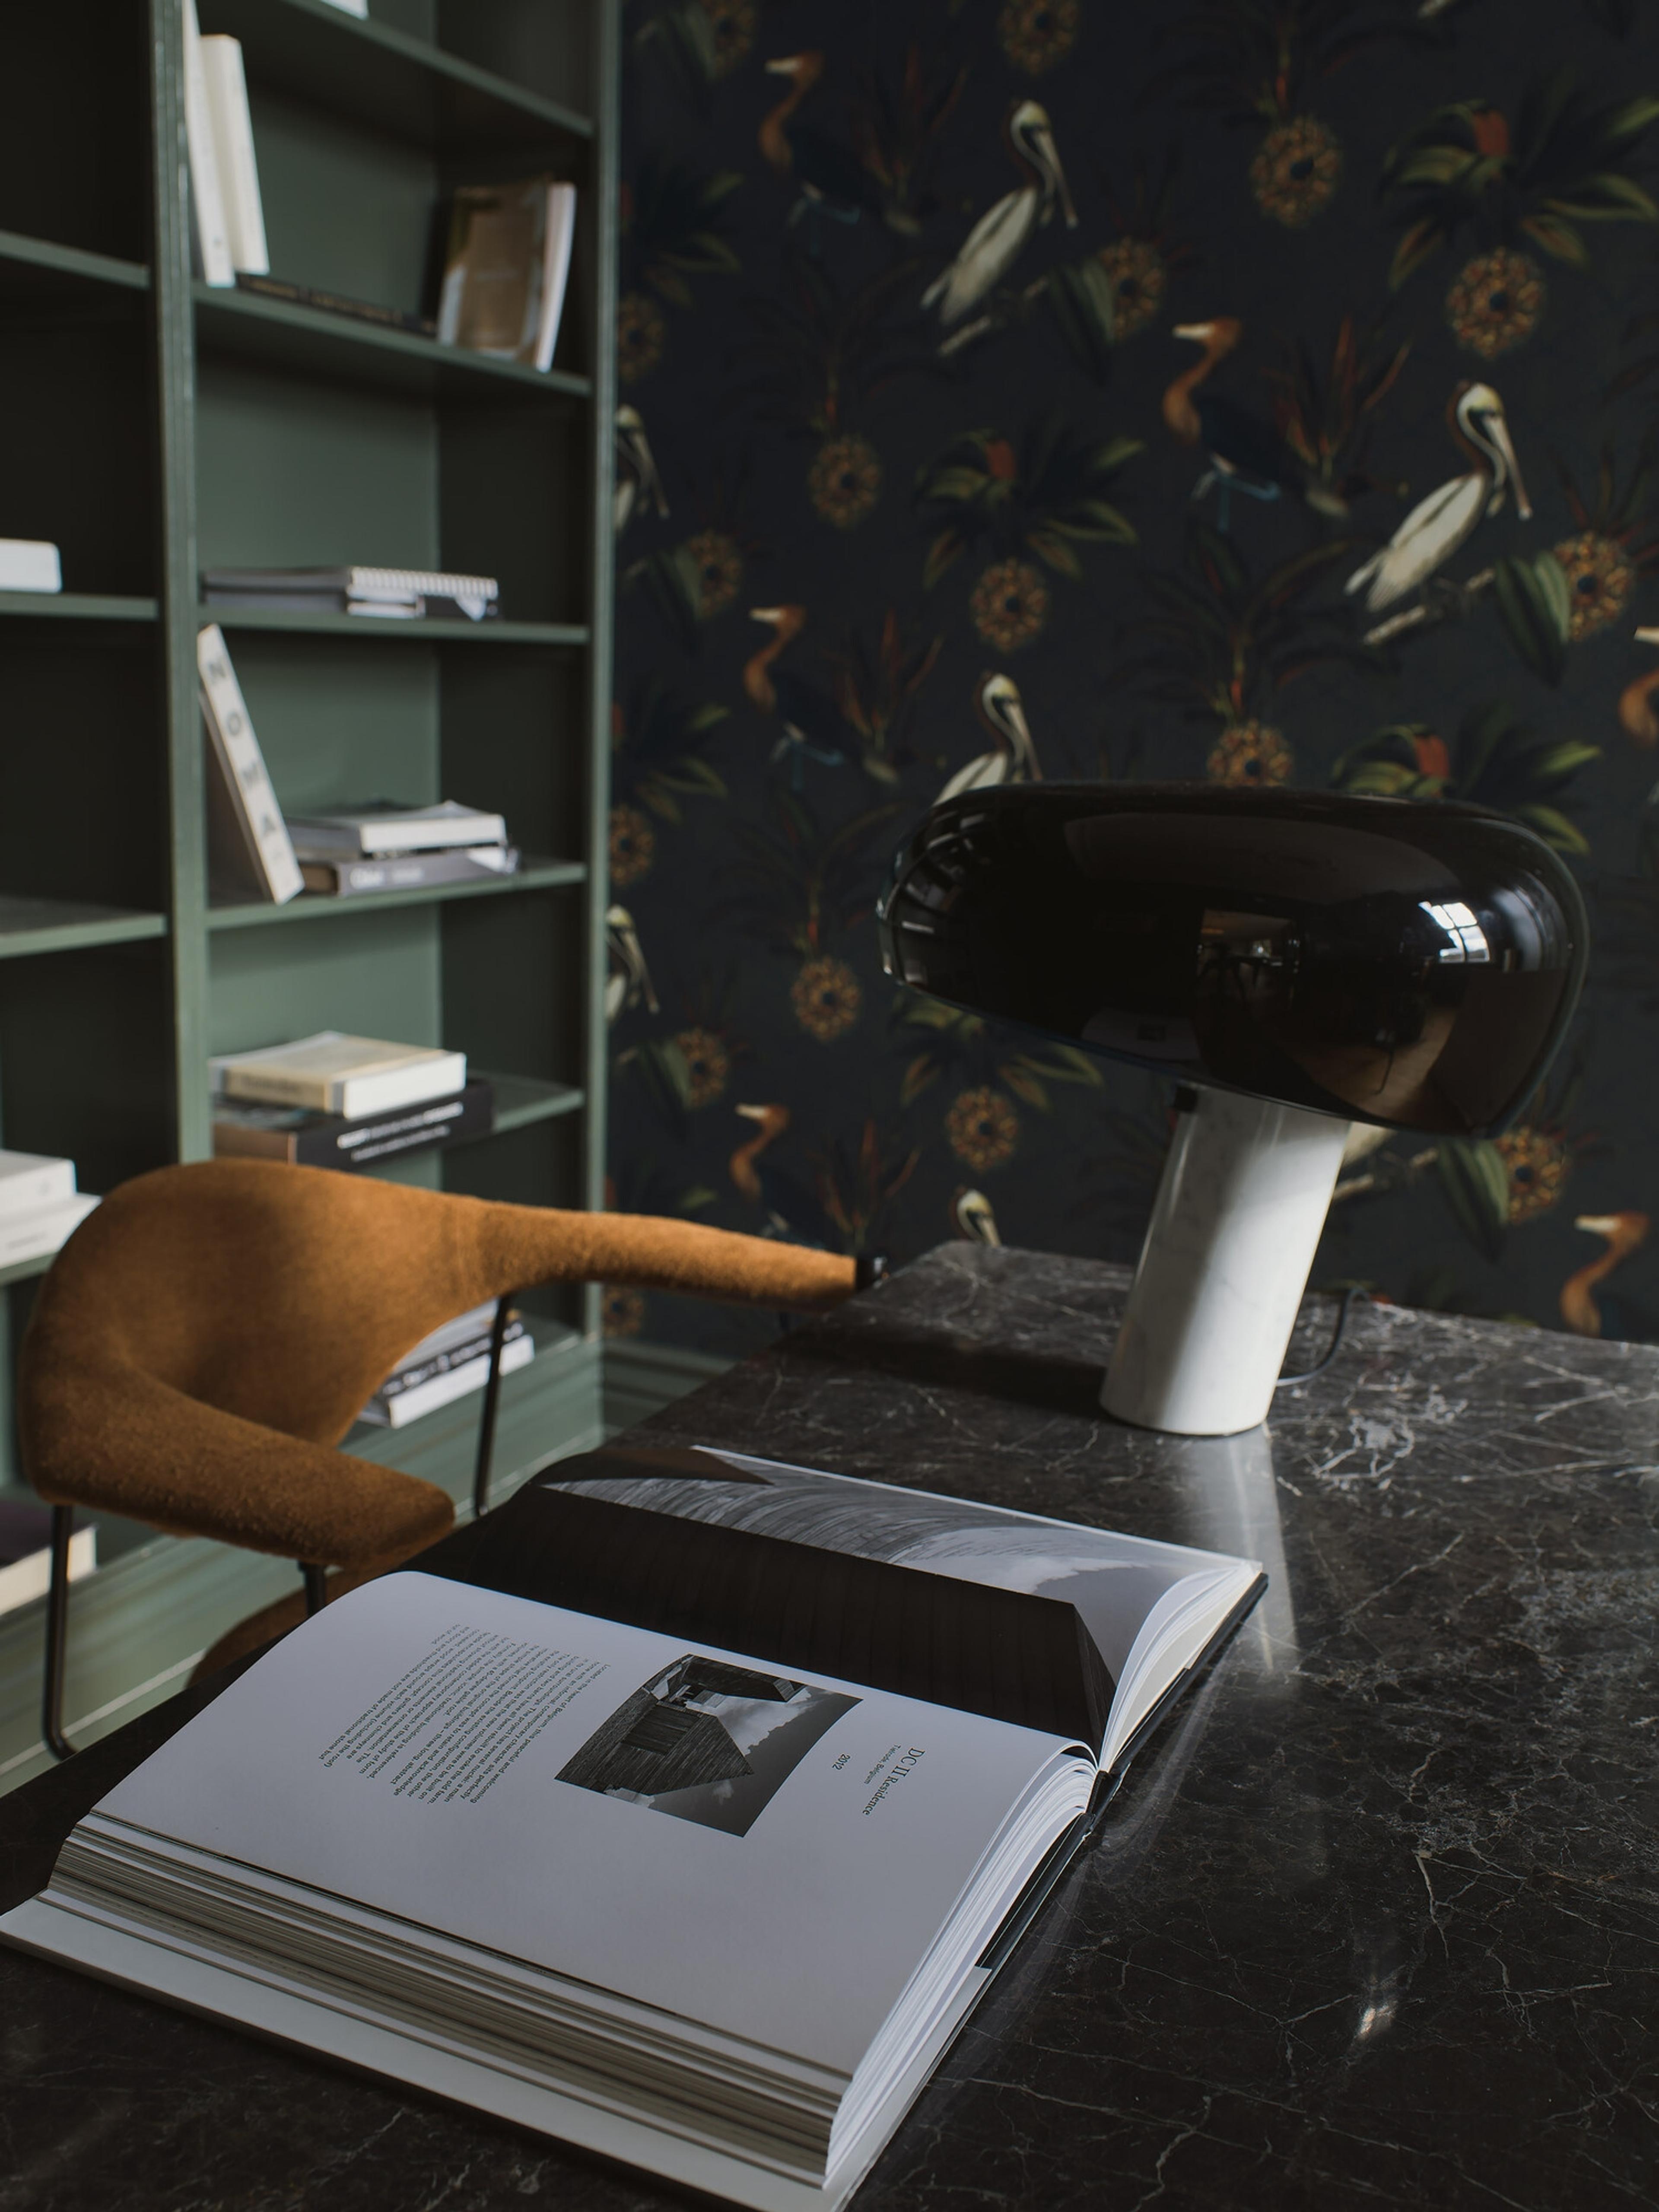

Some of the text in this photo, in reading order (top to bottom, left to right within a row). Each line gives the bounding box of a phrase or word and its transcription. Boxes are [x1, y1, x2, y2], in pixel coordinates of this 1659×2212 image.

[377, 1690, 393, 1704] made
[394, 1689, 408, 1700] each
[375, 1701, 395, 1719] volume
[391, 1697, 411, 1715] gutters
[409, 1701, 434, 1724] approach
[424, 1697, 452, 1723] traditional
[344, 1710, 374, 1735] traditional
[381, 1715, 393, 1726] and
[443, 1706, 470, 1729] buildings
[458, 1717, 470, 1727] was
[464, 1715, 486, 1735] existing
[485, 1717, 497, 1728] new
[496, 1717, 512, 1730] been
[347, 1719, 378, 1745] (including
[356, 1725, 382, 1749] chimneys
[394, 1730, 405, 1739] the
[401, 1722, 427, 1744] building
[464, 1729, 487, 1750] volumes
[480, 1730, 498, 1748] rebuilt
[528, 1729, 541, 1739] this
[329, 1735, 346, 1750] stone
[378, 1740, 395, 1754] study
[426, 1733, 442, 1748] three
[438, 1734, 454, 1749] retain
[496, 1735, 509, 1745] has
[318, 1750, 331, 1760] but
[338, 1744, 350, 1754] the
[346, 1750, 357, 1759] are
[427, 1749, 439, 1761] and
[478, 1745, 498, 1765] several
[493, 1738, 518, 1764] character
[508, 1738, 531, 1762] peaceful
[324, 1753, 340, 1767] roof)
[356, 1753, 371, 1763] The
[451, 1751, 466, 1764] were
[459, 1754, 476, 1770] evoke
[832, 1753, 851, 1770] 2012
[359, 1761, 375, 1773] form
[390, 1762, 414, 1785] abstract
[483, 1764, 495, 1775] sits
[498, 1761, 510, 1773] and
[864, 1763, 884, 1785] Belgium
[394, 1761, 429, 1796] acknowledge
[421, 1772, 433, 1782] the
[450, 1770, 462, 1780] the
[862, 1747, 926, 1816] DC II Residence
[407, 1782, 423, 1797] other
[426, 1778, 442, 1792] built
[441, 1780, 452, 1790] old
[460, 1775, 485, 1799] perfectly
[470, 1773, 500, 1803] welcoming
[418, 1792, 428, 1800] on
[444, 1788, 459, 1802] main
